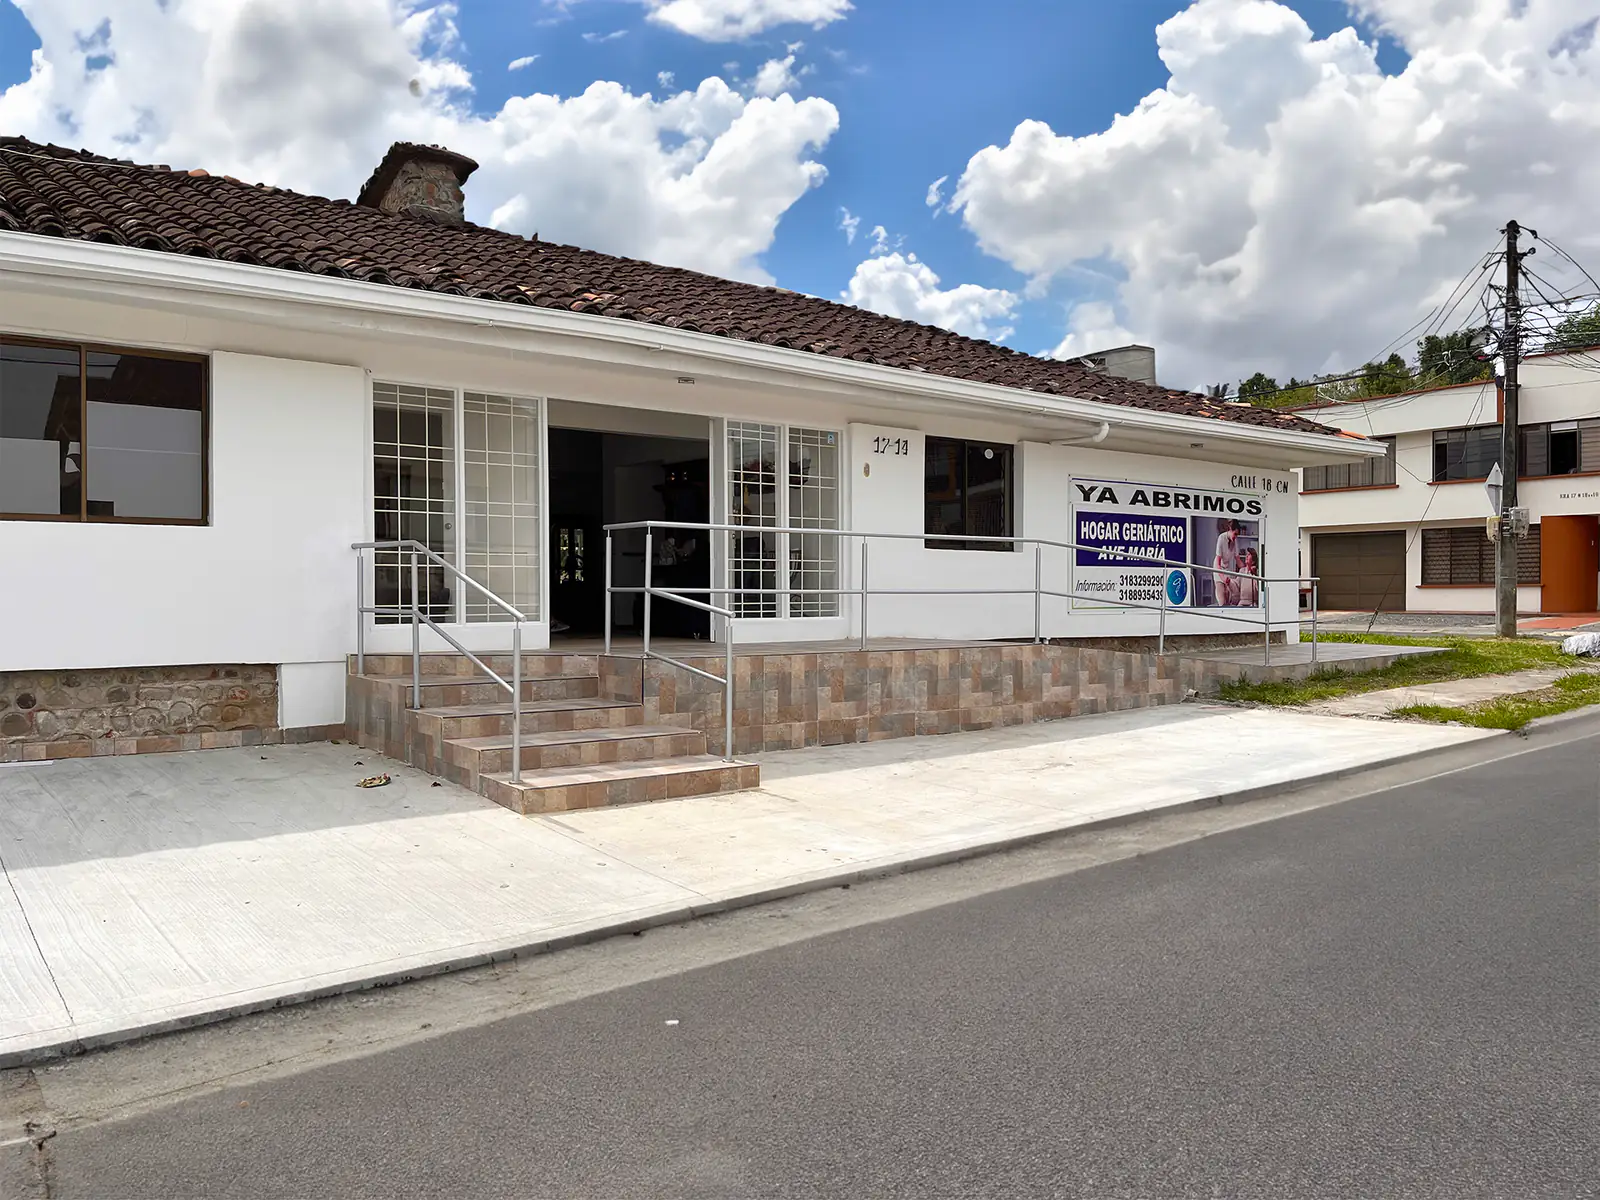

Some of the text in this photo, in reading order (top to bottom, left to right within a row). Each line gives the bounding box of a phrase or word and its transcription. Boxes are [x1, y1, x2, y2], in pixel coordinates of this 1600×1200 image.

[1231, 475, 1256, 489] CALLE
[1262, 478, 1272, 491] 18
[1075, 484, 1262, 515] YA ABRIMOS
[1080, 520, 1184, 544] HOGAR GERIÁTRICO
[1098, 544, 1166, 561] AVE MARÍA
[1075, 579, 1117, 592] Información:
